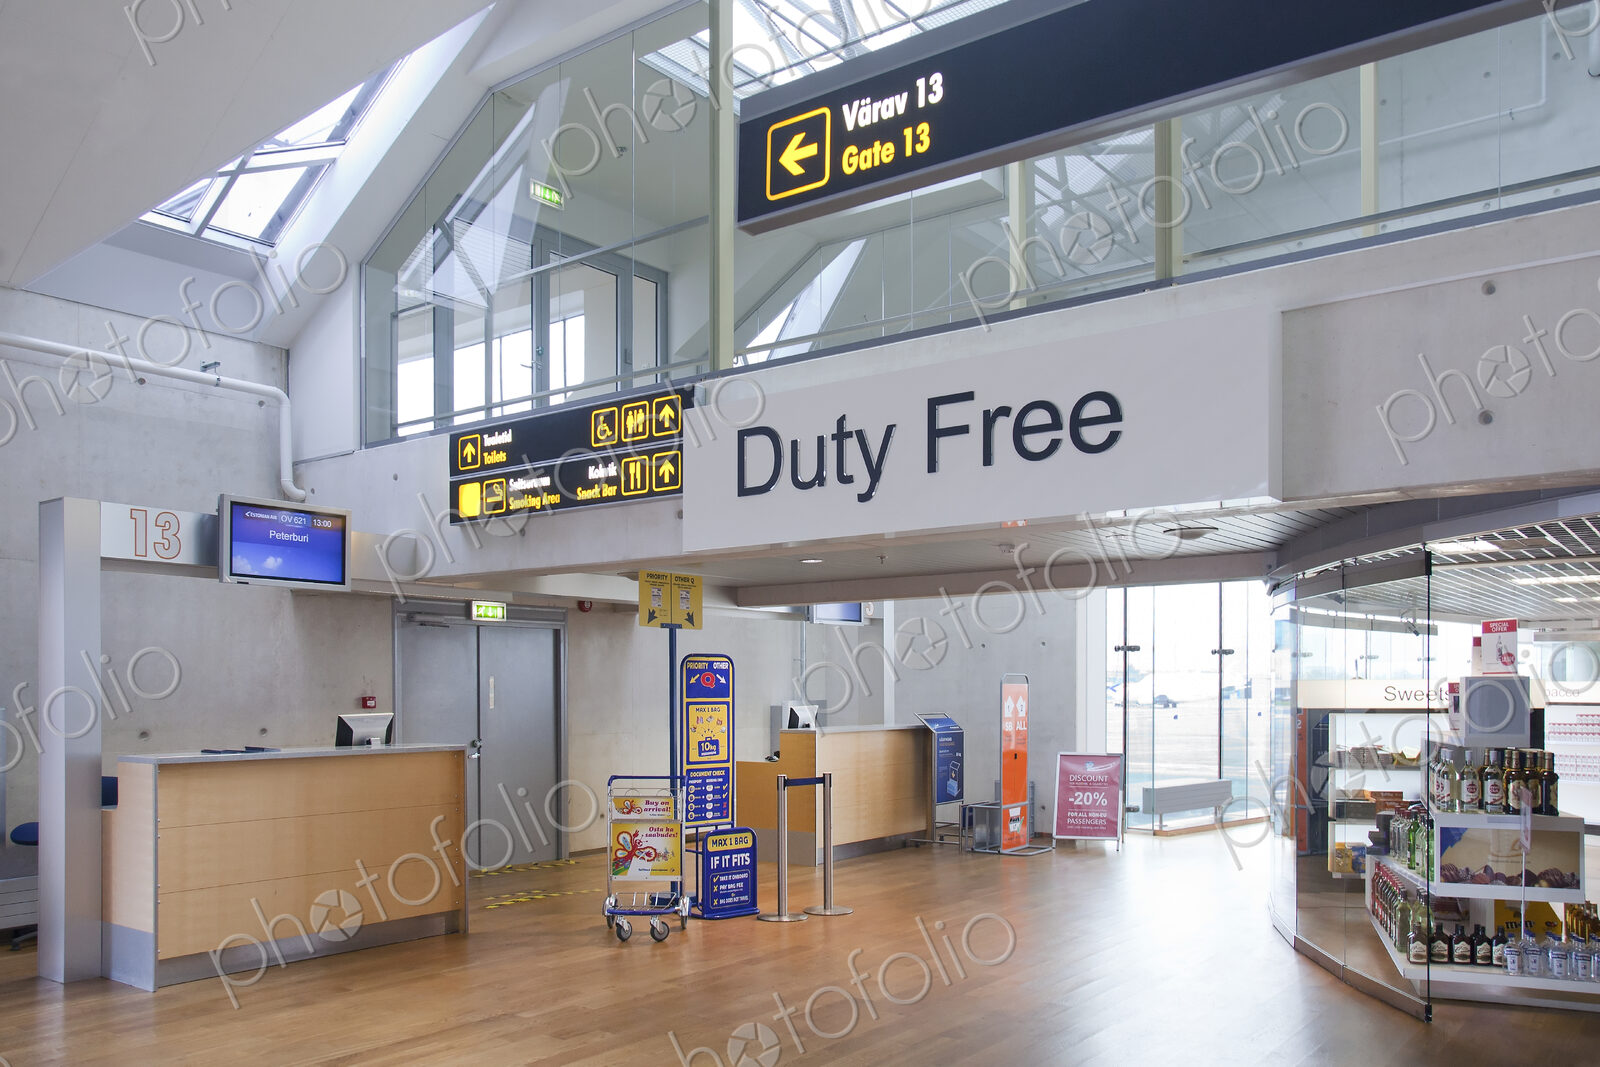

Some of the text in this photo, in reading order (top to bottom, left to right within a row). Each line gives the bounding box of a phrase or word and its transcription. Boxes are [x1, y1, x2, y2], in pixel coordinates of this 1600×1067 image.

[842, 72, 944, 131] Värav 13
[841, 122, 931, 175] Gate 13
[737, 390, 1123, 503] Duty Free
[483, 450, 506, 464] Toilets
[577, 484, 617, 500] Snack Bar
[509, 492, 560, 509] Smoking Area
[313, 519, 332, 528] 13:00
[130, 508, 181, 559] 13
[270, 530, 308, 542] Peterburi
[700, 672, 715, 688] Q
[1016, 720, 1027, 730] ALL
[701, 742, 716, 752] 10kg
[1068, 792, 1108, 806] -20%
[712, 838, 728, 847] MAX
[735, 836, 748, 845] BAG
[711, 853, 750, 869] IF IT FITS
